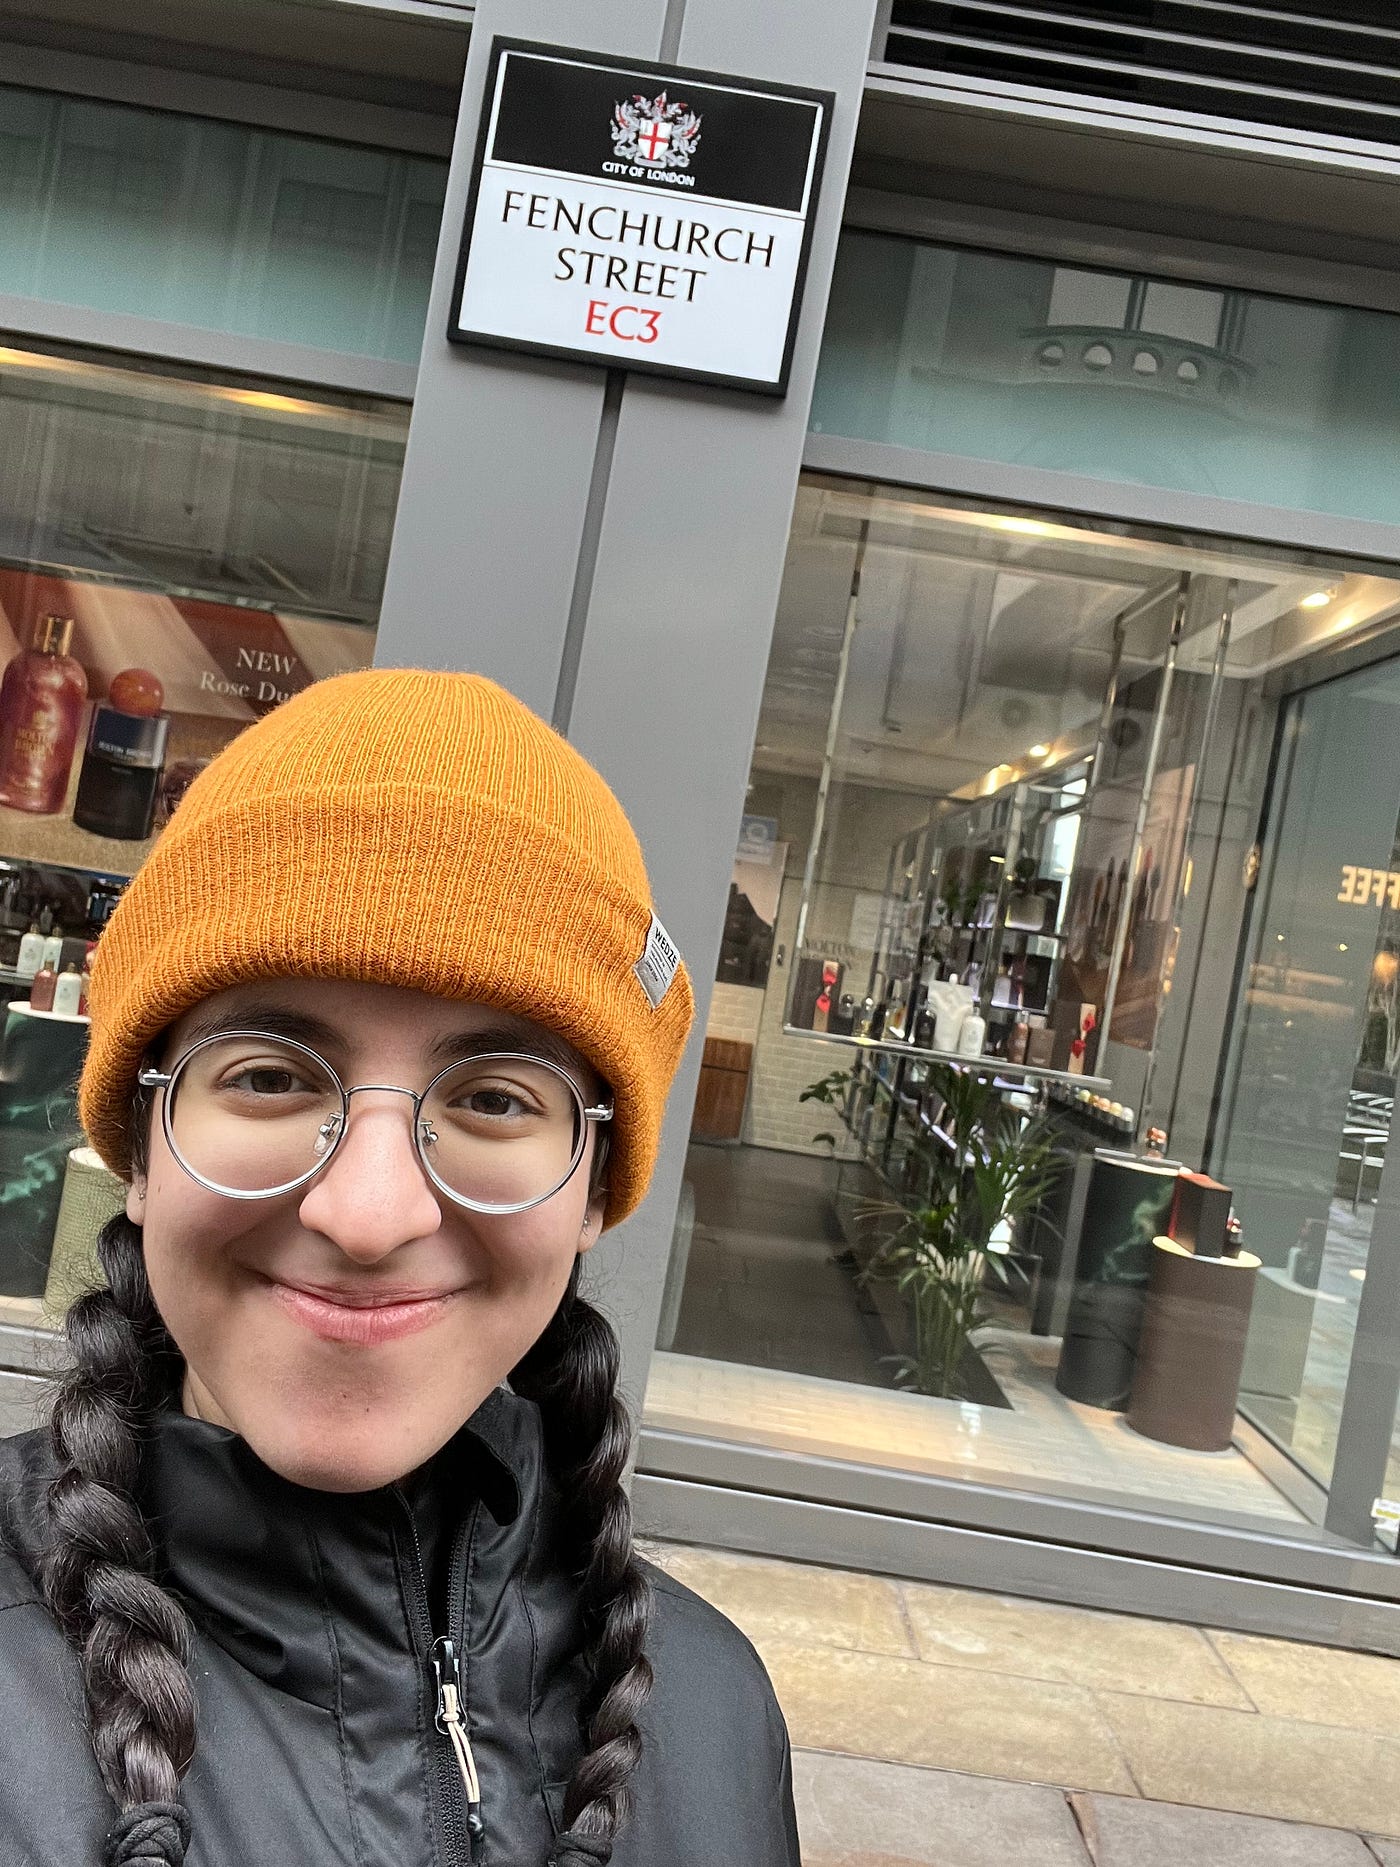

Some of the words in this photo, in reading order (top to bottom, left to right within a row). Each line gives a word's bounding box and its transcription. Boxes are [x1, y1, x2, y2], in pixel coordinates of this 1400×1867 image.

[602, 161, 629, 175] CITY
[628, 166, 645, 178] OF
[646, 168, 695, 187] LONDON
[501, 189, 776, 268] FENCHURCH
[554, 246, 707, 303] STREET
[584, 299, 663, 345] EC3
[236, 646, 298, 676] NEW
[200, 670, 250, 698] Rose
[257, 681, 292, 704] Du
